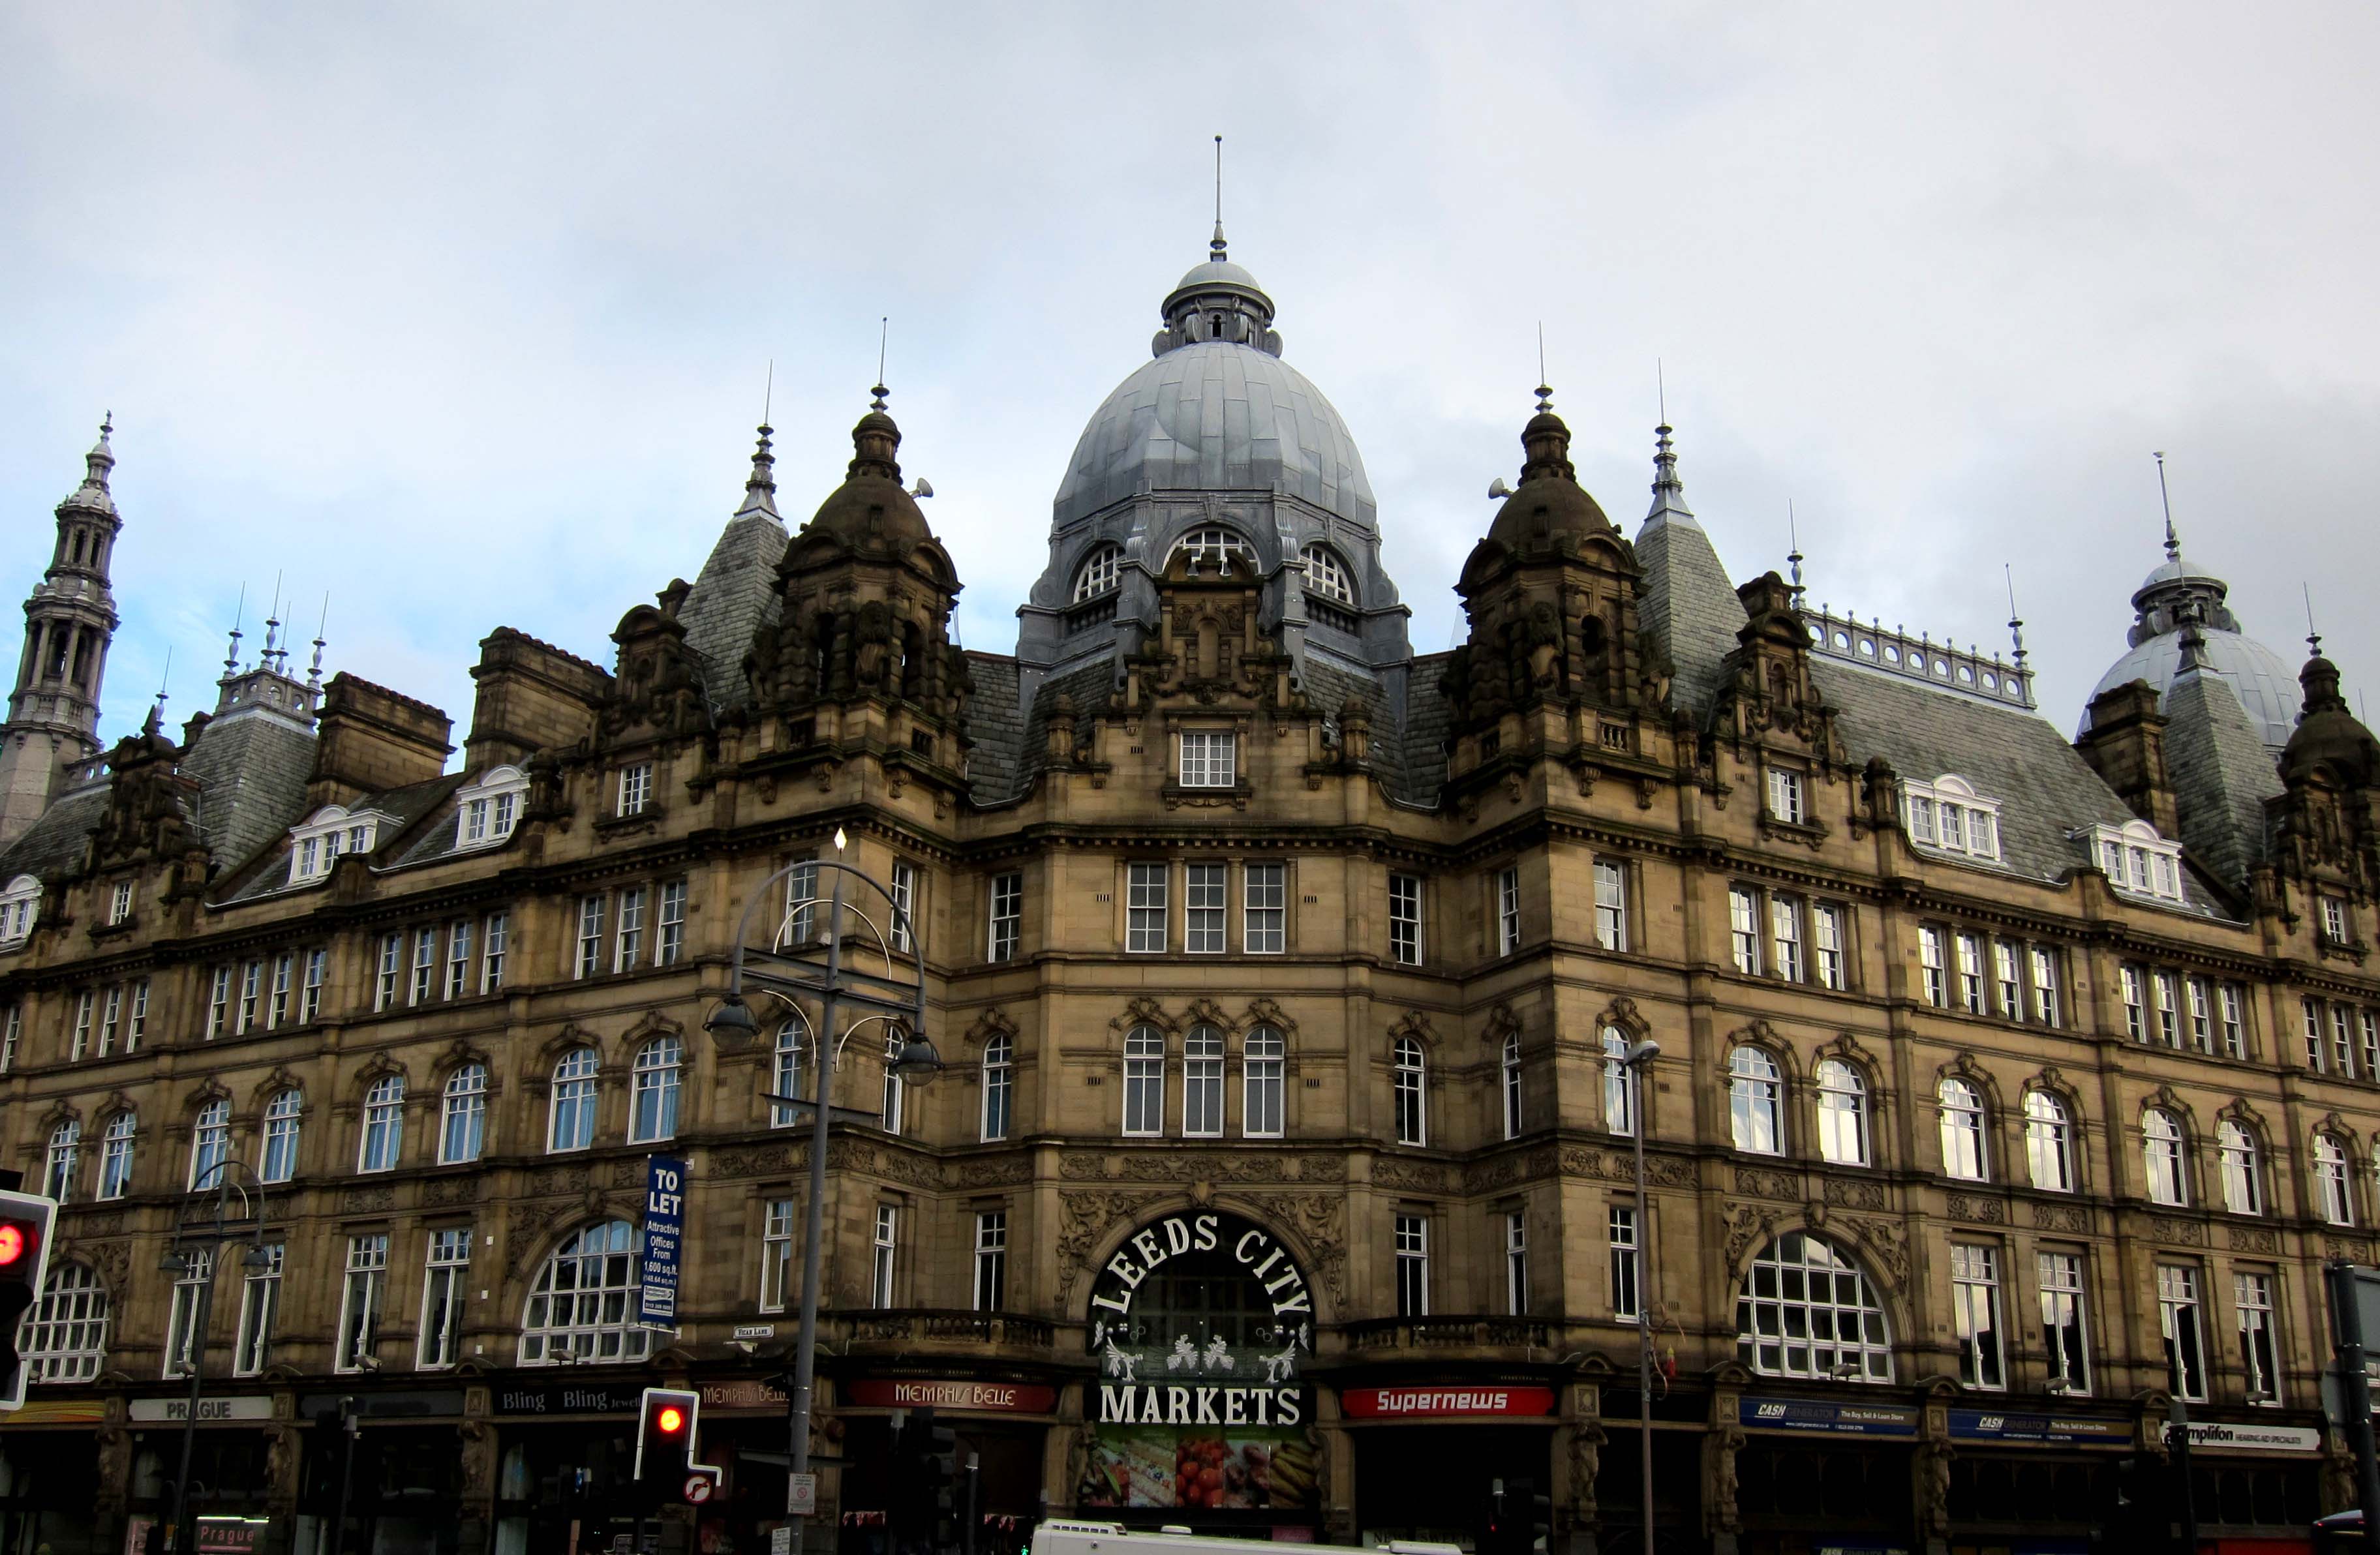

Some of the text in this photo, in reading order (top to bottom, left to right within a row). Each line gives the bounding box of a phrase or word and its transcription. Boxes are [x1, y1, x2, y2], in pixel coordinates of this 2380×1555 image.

[655, 1168, 679, 1192] TO
[648, 1190, 682, 1216] LET
[647, 1220, 680, 1236] Attractive
[650, 1235, 675, 1250] Offices
[652, 1247, 671, 1261] From
[644, 1260, 662, 1274] 1,600
[1091, 1215, 1311, 1316] LEEDS CITY
[502, 1390, 546, 1412] Bling
[563, 1389, 608, 1412] Bling
[703, 1384, 790, 1404] MEMPHIS BELL
[895, 1383, 1016, 1406] MEMPHIS BELLE
[1377, 1390, 1508, 1413] Supernews
[166, 1402, 232, 1419] PRGUE
[1099, 1385, 1300, 1426] MARKETS
[1758, 1404, 1786, 1417] CASH
[1978, 1416, 2005, 1428] CASH
[2188, 1424, 2233, 1443] mplifon
[200, 1525, 254, 1545] Prague
